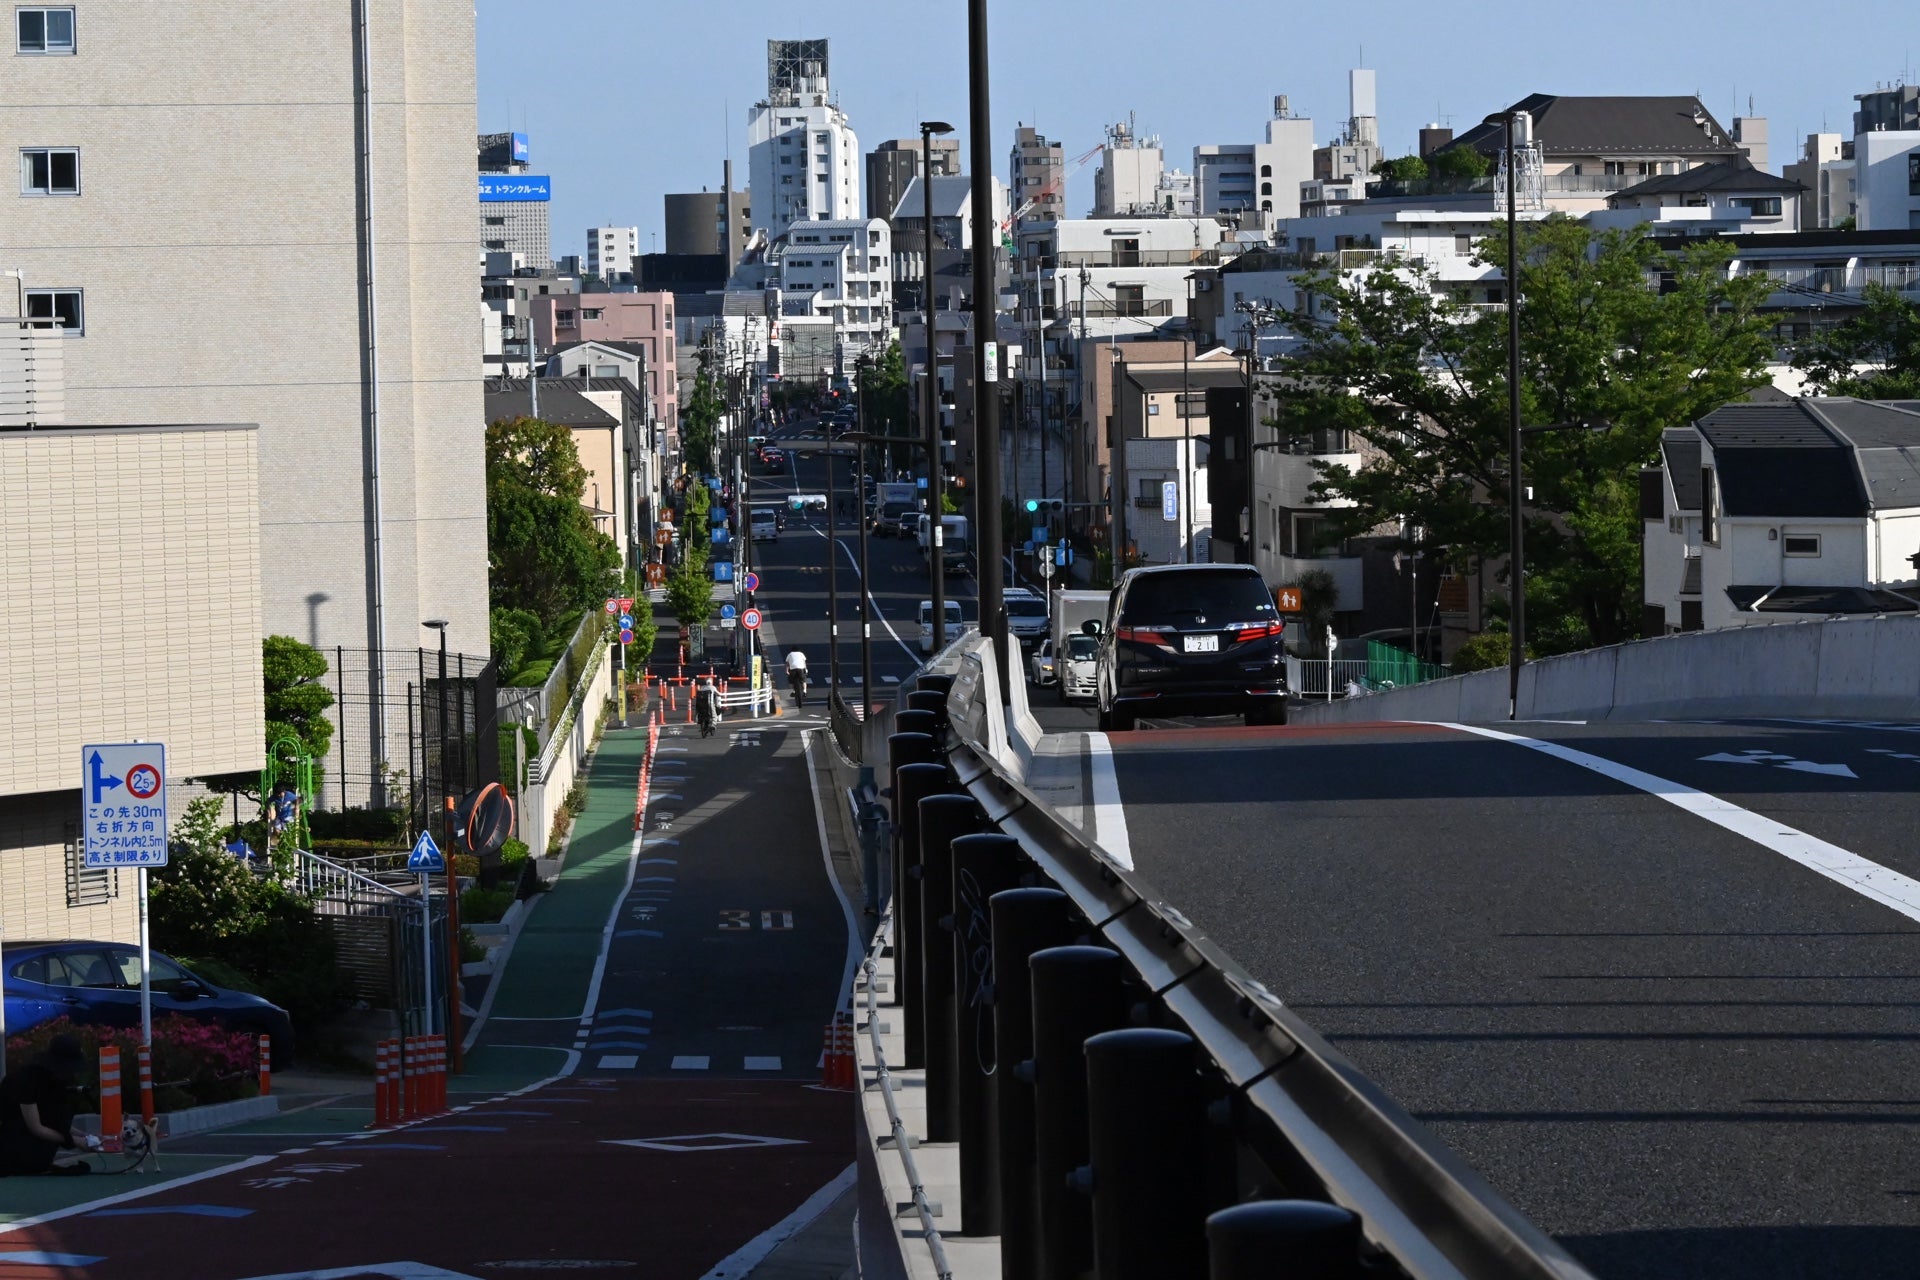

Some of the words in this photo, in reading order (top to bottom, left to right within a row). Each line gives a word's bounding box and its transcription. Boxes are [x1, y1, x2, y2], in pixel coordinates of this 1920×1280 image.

[496, 185, 547, 194] トランクルーム
[746, 614, 758, 624] 40
[96, 820, 154, 833] 右折方向
[89, 835, 163, 848] トンネル内2.5m
[89, 850, 162, 863] 高さ制限あり
[718, 910, 794, 930] 30
